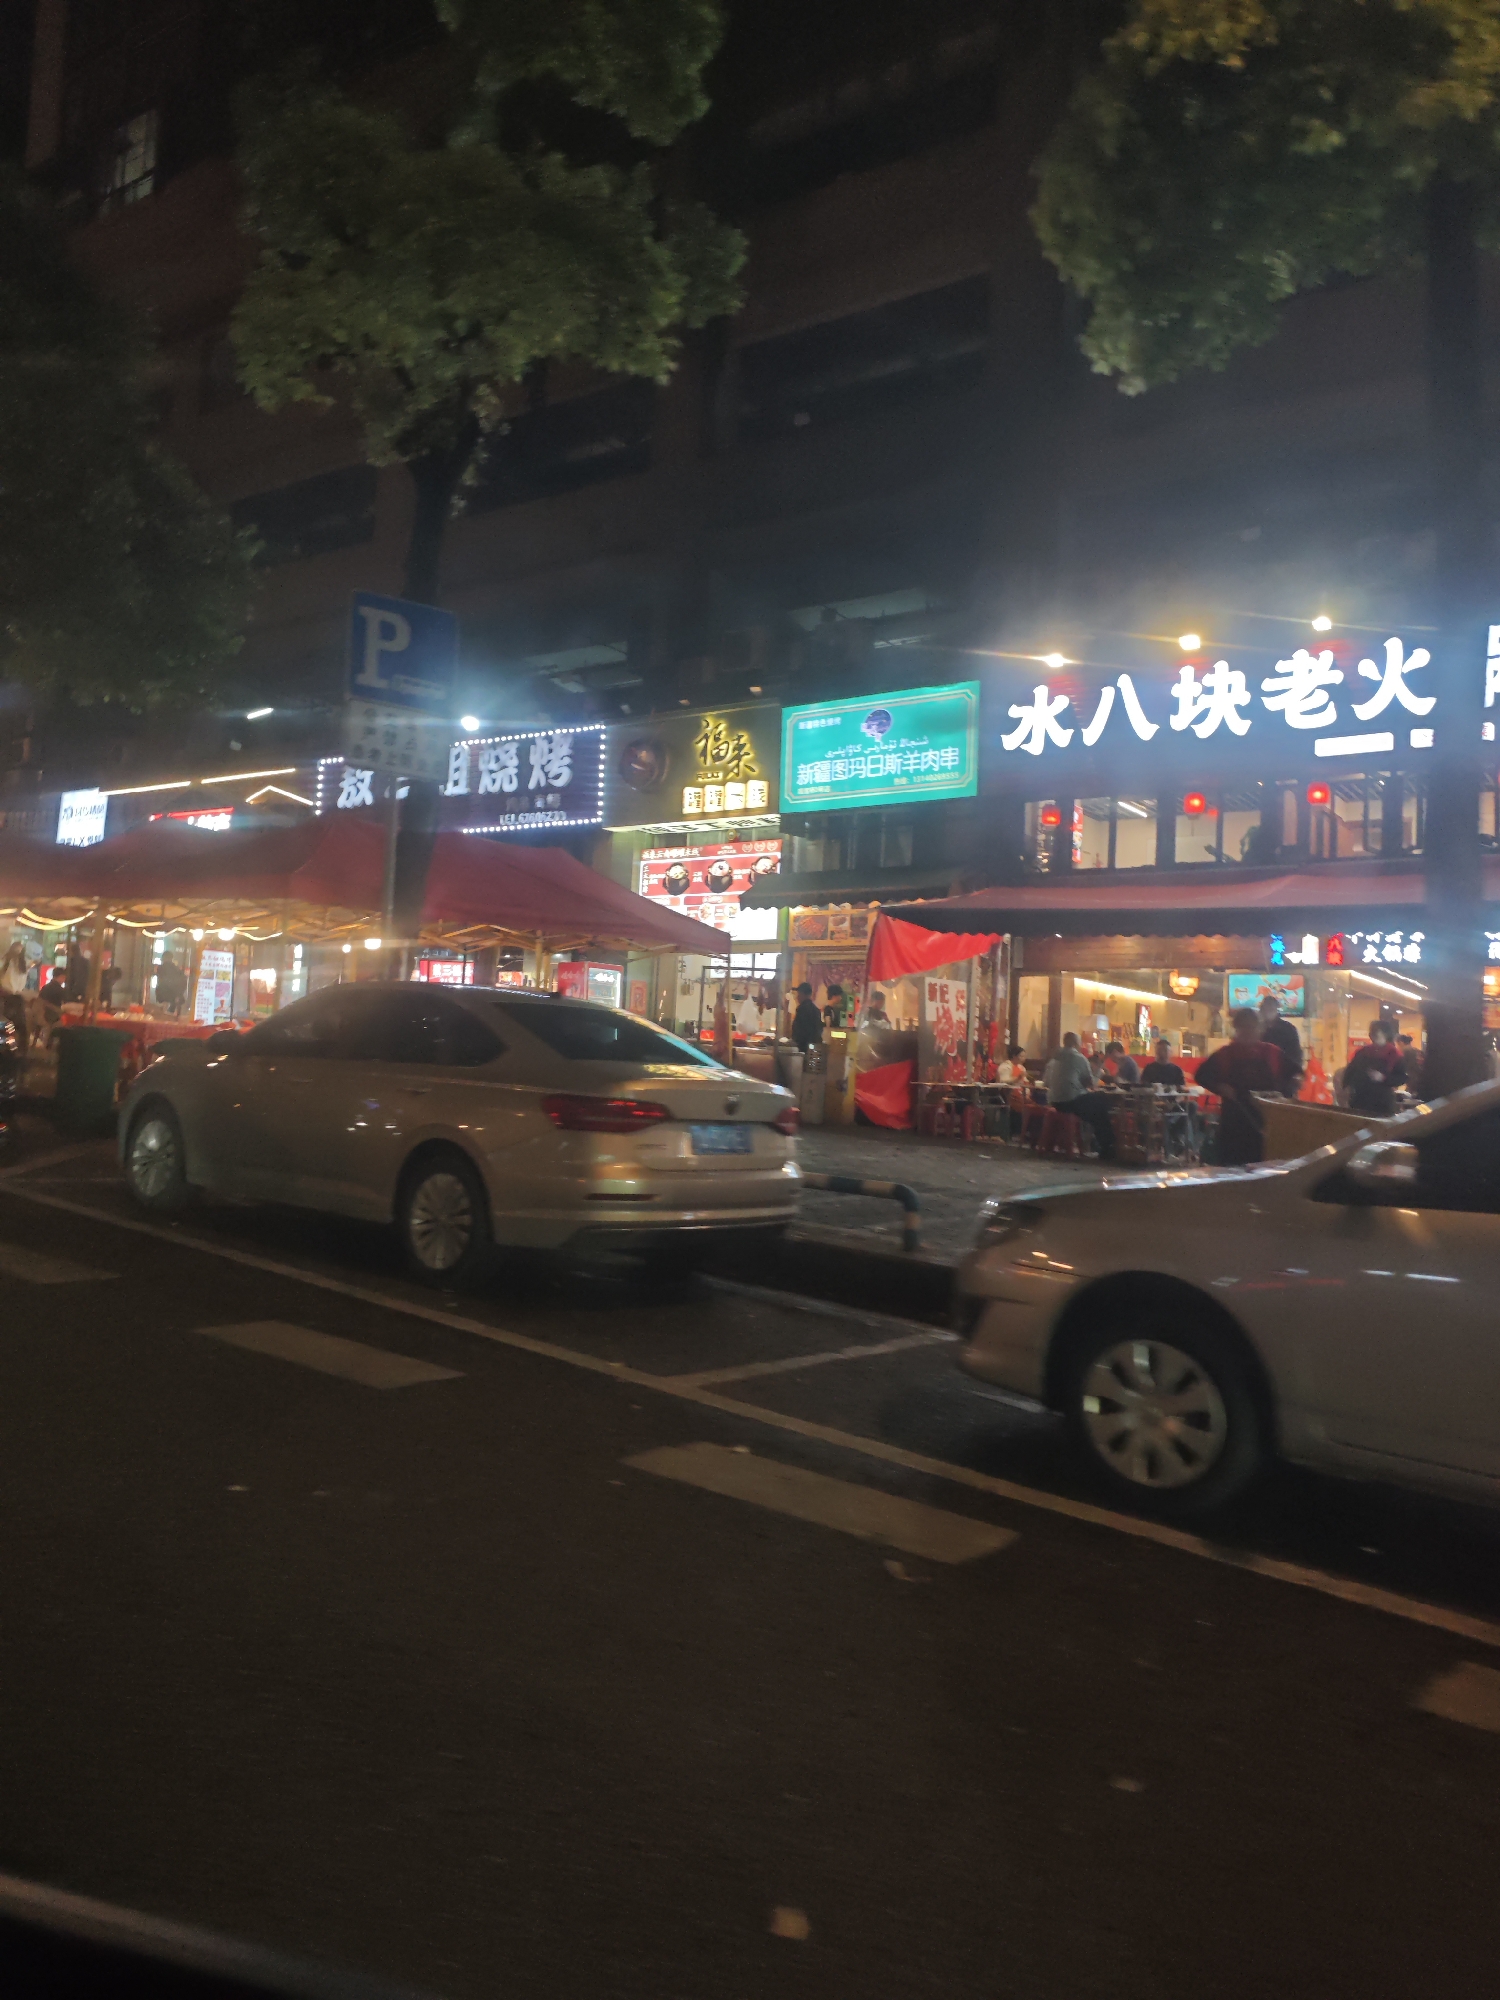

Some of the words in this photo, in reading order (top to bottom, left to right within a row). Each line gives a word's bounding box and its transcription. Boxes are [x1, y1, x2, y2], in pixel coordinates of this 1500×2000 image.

[357, 605, 411, 688] P
[796, 747, 960, 786] 新疆图玛日斯羊肉串
